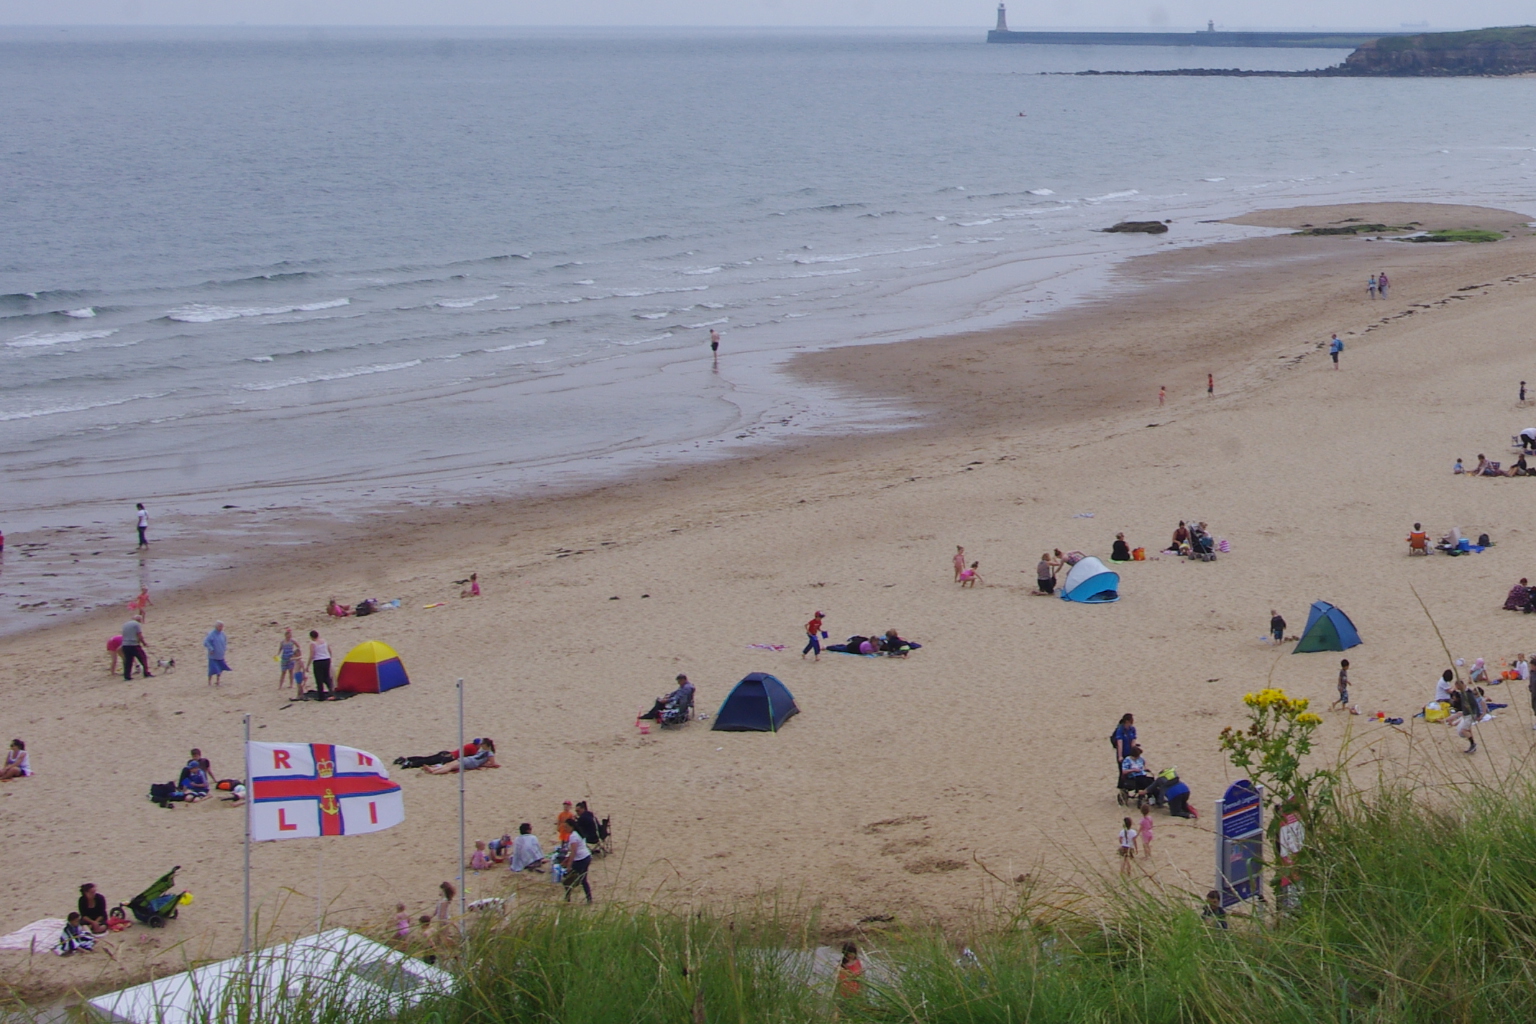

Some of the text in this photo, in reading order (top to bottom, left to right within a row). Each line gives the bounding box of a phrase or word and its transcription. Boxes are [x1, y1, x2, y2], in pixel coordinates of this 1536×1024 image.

[273, 749, 292, 769] R
[278, 801, 378, 830] L I
